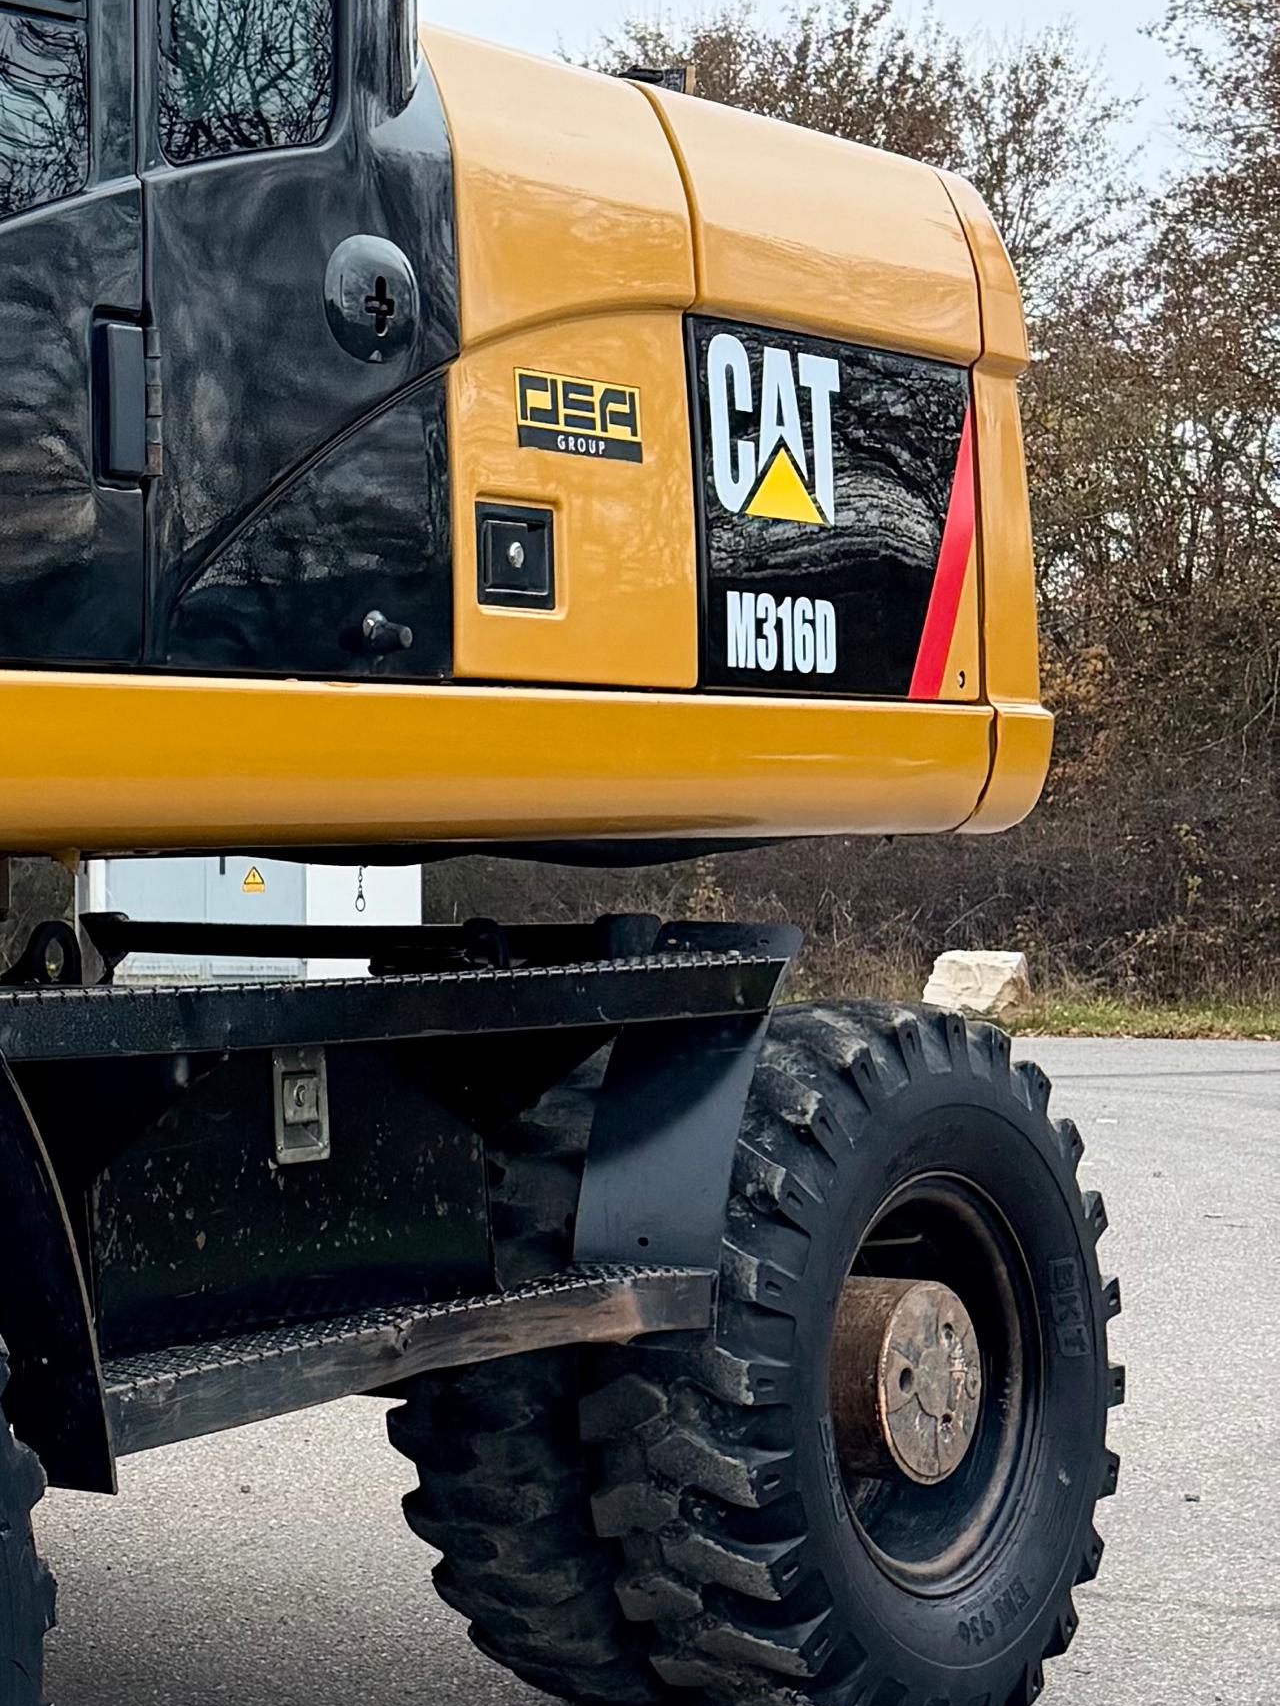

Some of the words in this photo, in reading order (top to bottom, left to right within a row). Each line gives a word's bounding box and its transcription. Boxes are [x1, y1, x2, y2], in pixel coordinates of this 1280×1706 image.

[557, 435, 606, 455] GROUP
[707, 334, 840, 526] CAT
[726, 591, 837, 675] M316D
